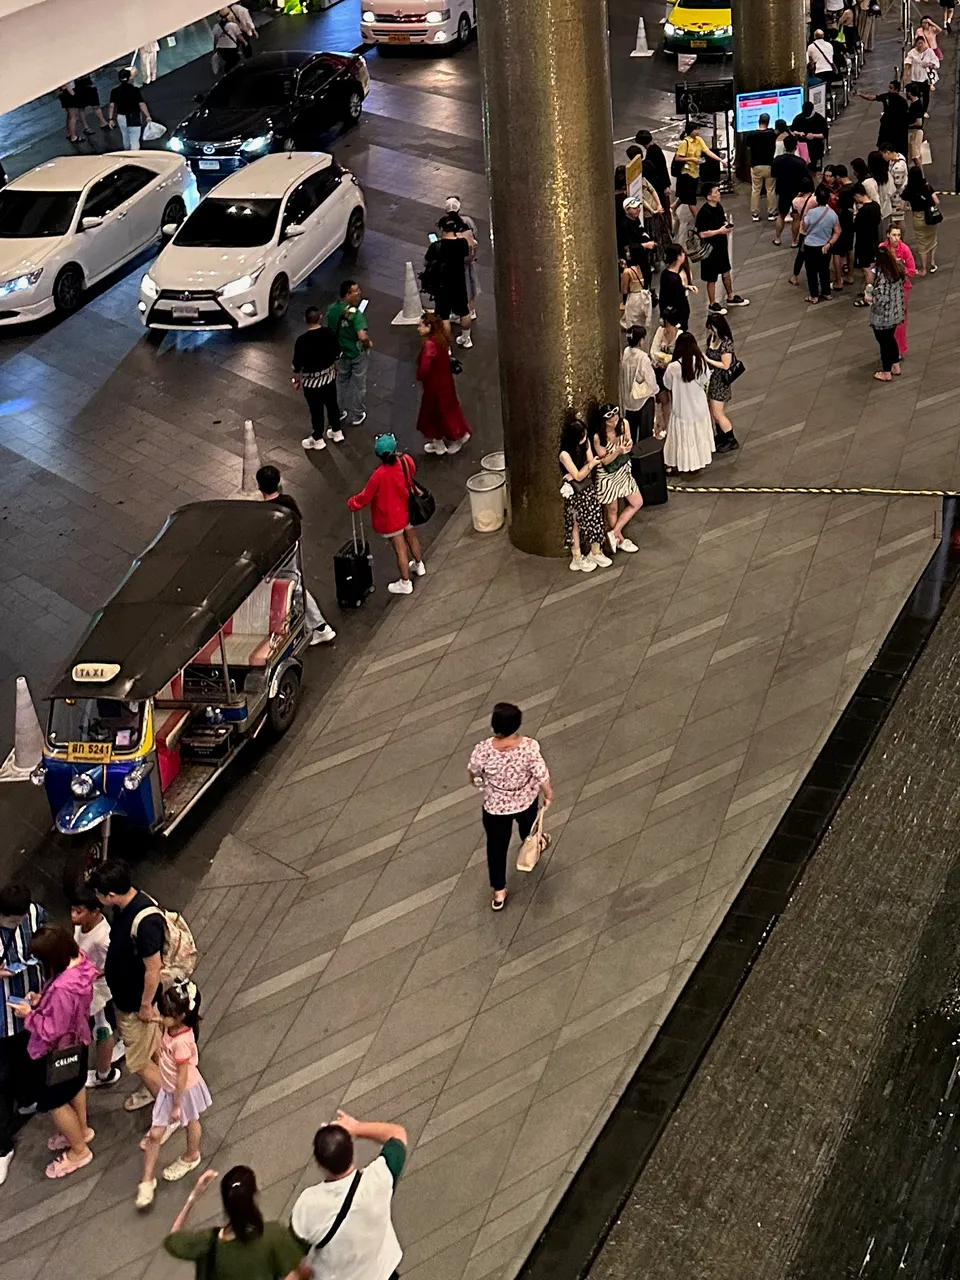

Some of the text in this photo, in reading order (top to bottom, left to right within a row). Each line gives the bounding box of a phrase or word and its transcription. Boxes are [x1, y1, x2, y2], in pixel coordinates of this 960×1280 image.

[80, 669, 104, 677] TAXI
[88, 744, 110, 755] 5241
[55, 1054, 77, 1067] CELINE
